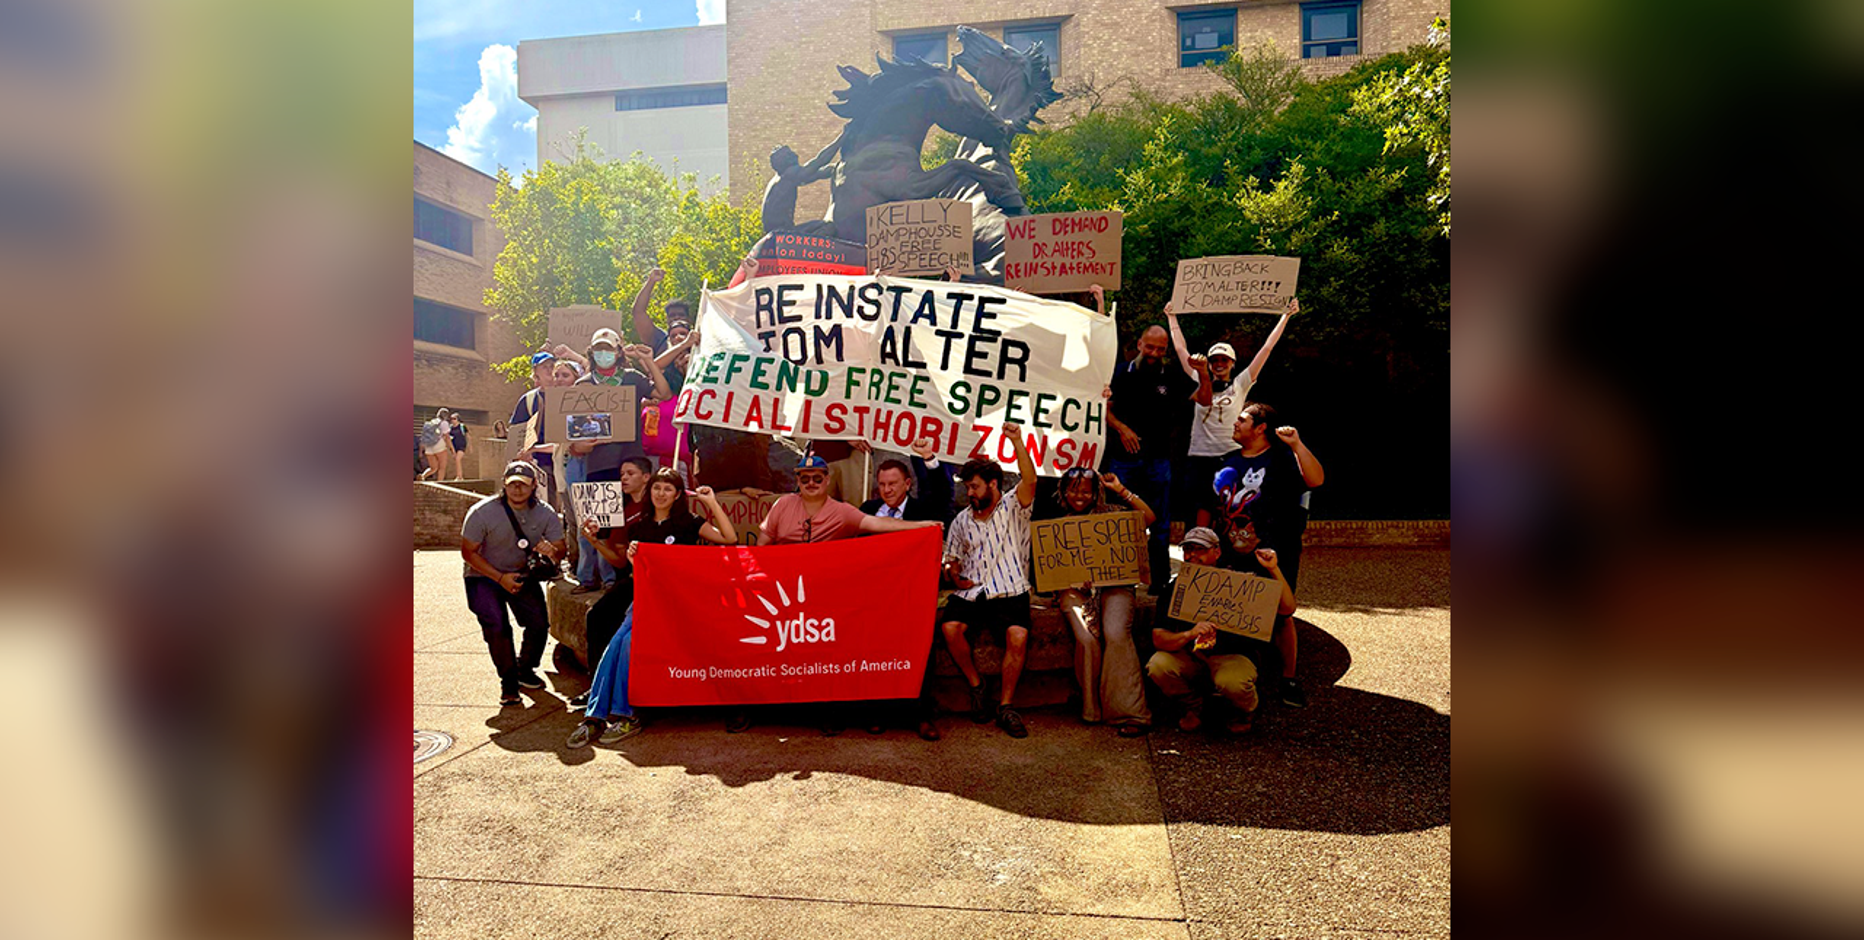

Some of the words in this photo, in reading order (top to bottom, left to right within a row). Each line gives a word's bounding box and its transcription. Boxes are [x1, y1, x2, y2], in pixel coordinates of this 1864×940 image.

[877, 201, 953, 229] KELLY
[1006, 219, 1036, 240] WE
[1051, 215, 1109, 236] DEMAND
[775, 234, 835, 249] WORKERS:
[899, 239, 942, 253] FREE
[755, 282, 1007, 337] REINSTATE
[757, 323, 845, 366] TOM
[880, 324, 1031, 382] ALTER
[686, 352, 829, 396] DEFEND
[845, 366, 930, 408] FREE
[947, 380, 1103, 435] SPEECH
[776, 612, 836, 652] ydsa
[668, 666, 707, 681] Young
[709, 664, 776, 679] Democratic
[780, 661, 841, 676] Socialists
[844, 660, 857, 672] of
[859, 657, 911, 672] America
